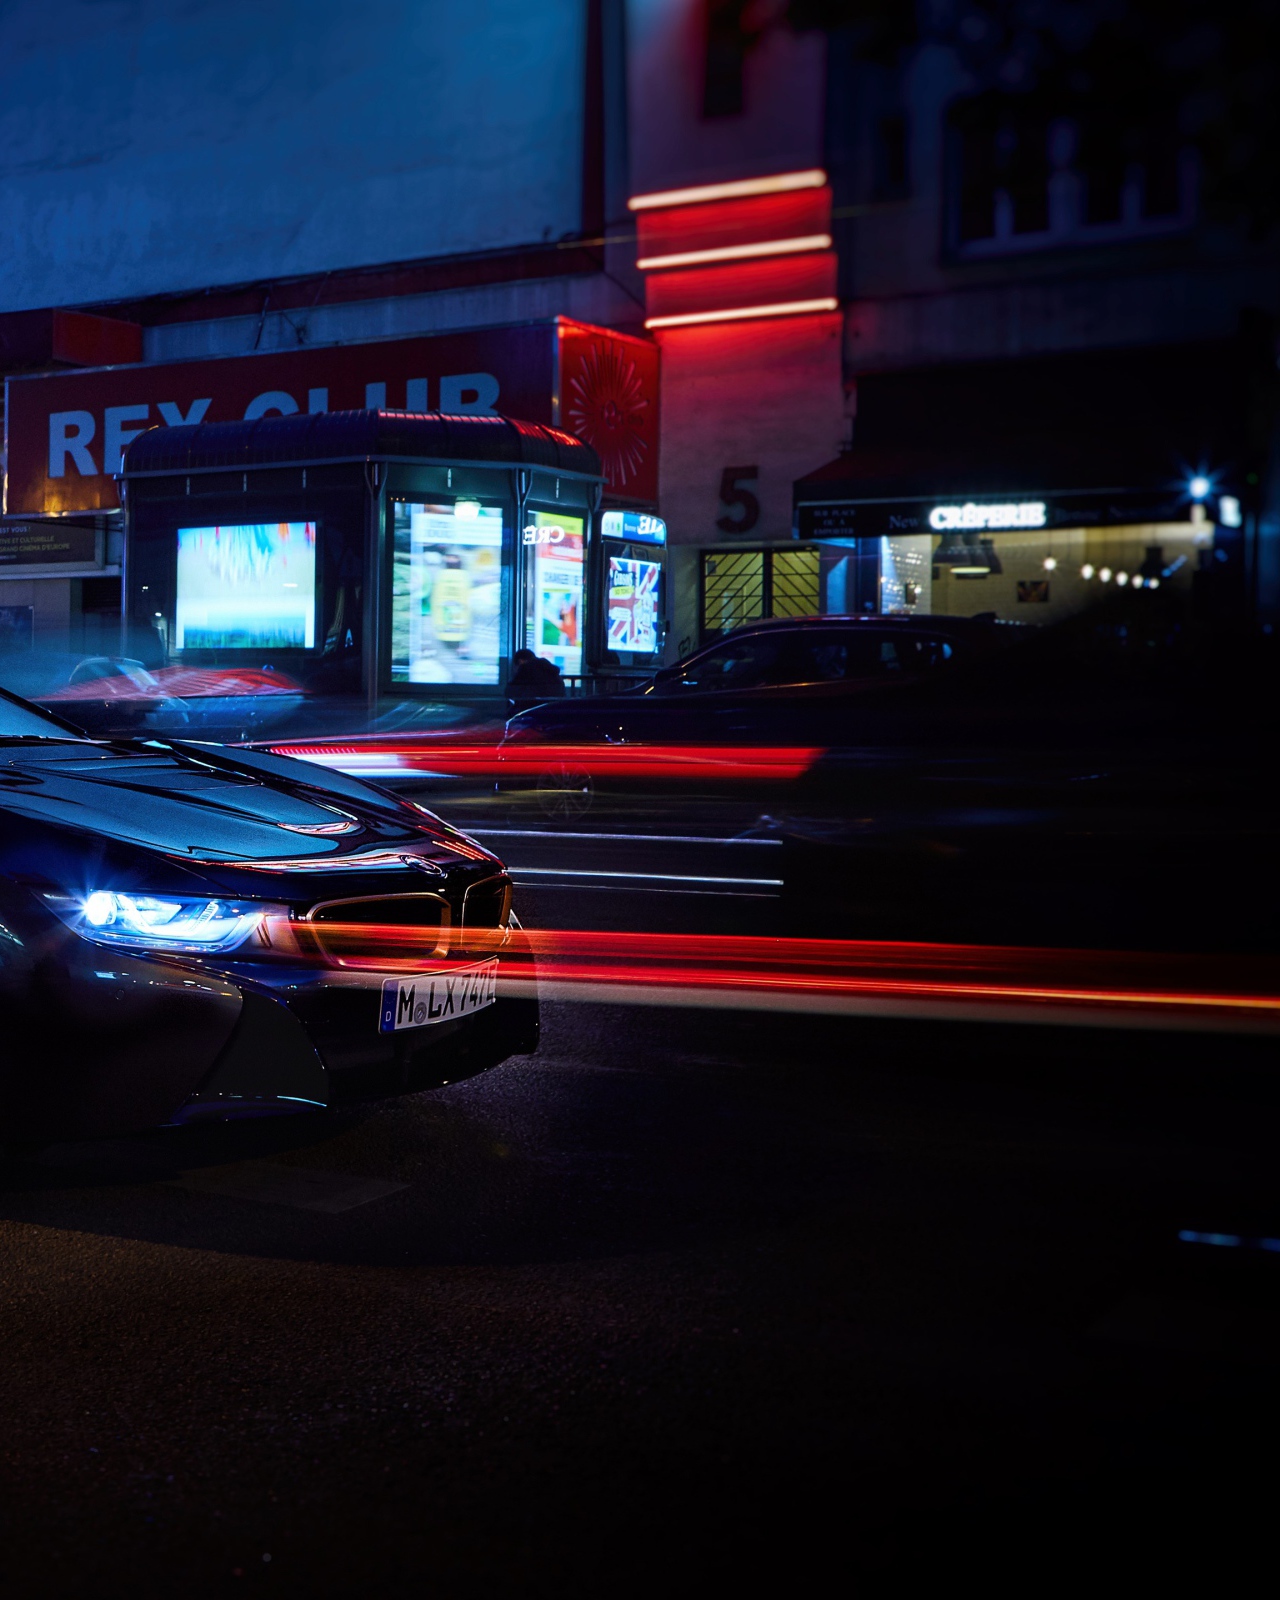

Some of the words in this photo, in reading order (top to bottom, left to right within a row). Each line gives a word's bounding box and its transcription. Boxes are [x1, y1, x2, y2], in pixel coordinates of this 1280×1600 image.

[716, 465, 760, 534] 5
[930, 503, 1045, 529] CRÊPERIE
[19, 535, 55, 543] CULTURELLE
[385, 1010, 392, 1022] D
